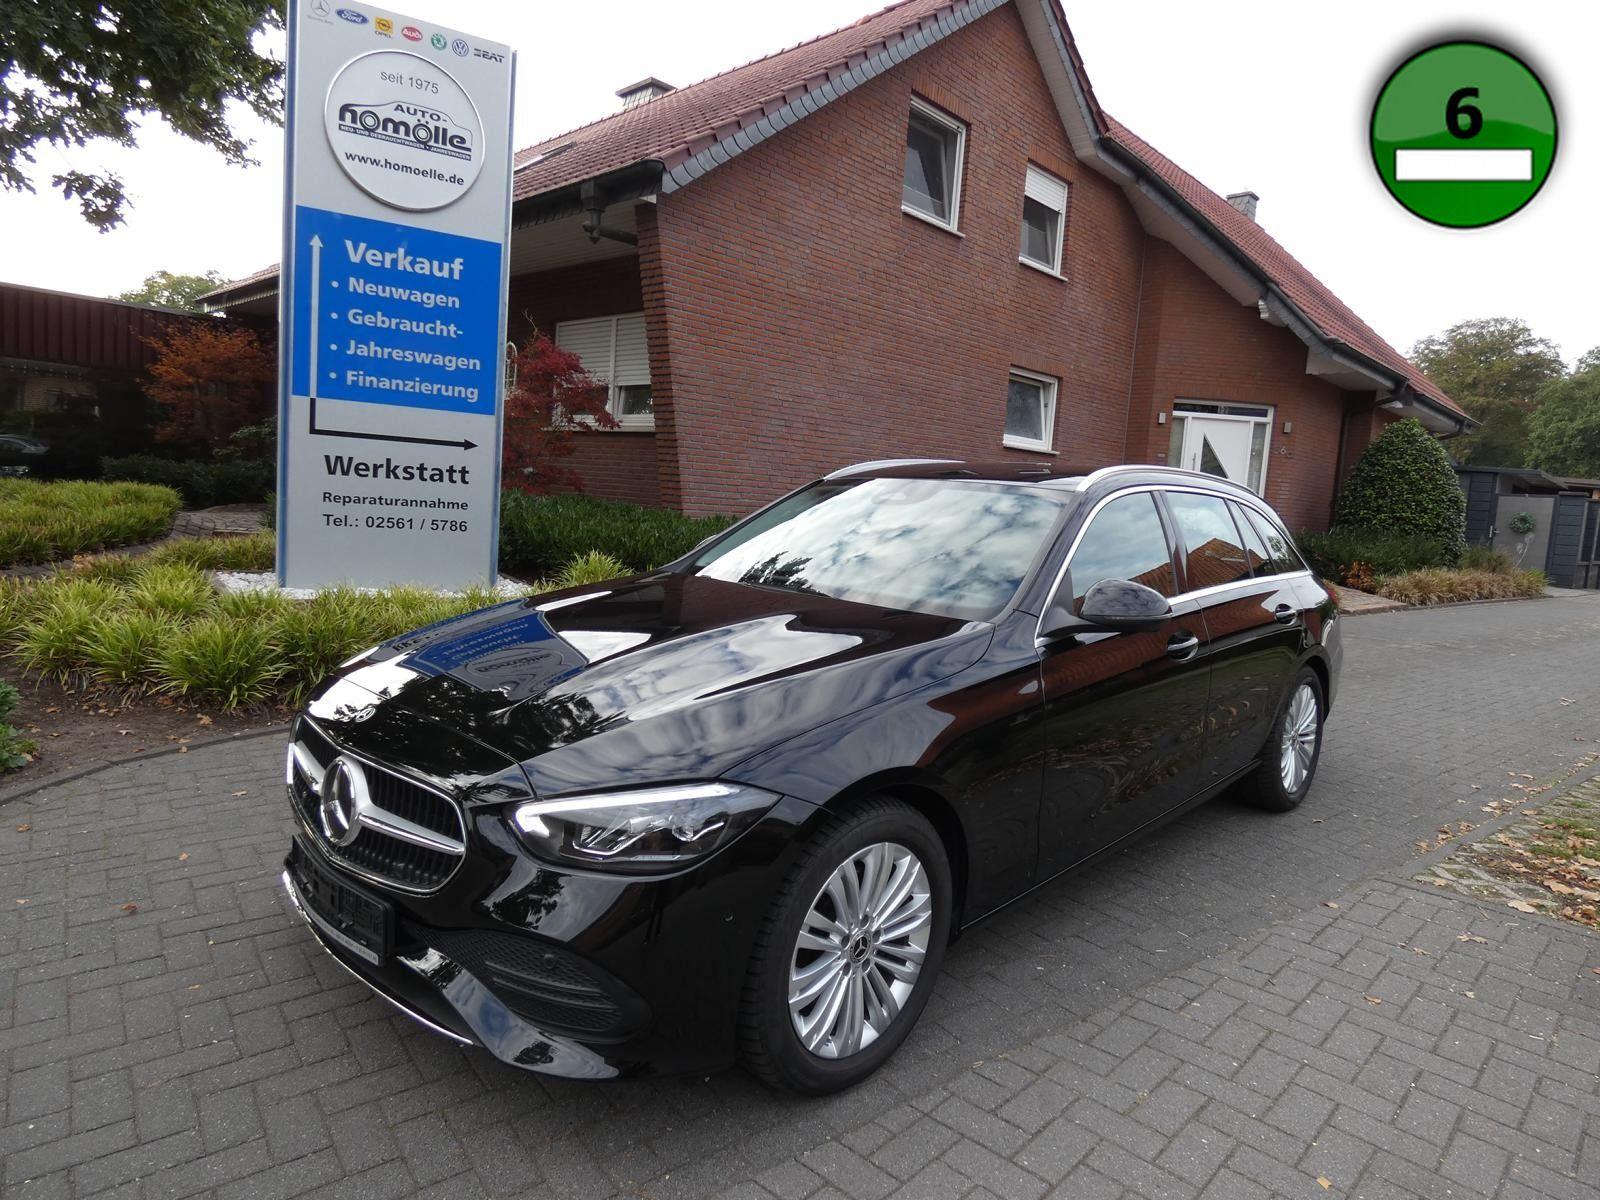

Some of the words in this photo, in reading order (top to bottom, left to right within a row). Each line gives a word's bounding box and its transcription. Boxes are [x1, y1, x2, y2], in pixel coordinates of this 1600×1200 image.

[402, 28, 422, 39] Audi
[473, 47, 505, 63] SEAT
[380, 70, 403, 87] seit
[408, 77, 439, 94] 1975
[344, 151, 465, 186] www.homoelle.de
[344, 239, 464, 281] Verkauf
[348, 276, 460, 309] Neuwagen
[347, 308, 464, 339] Gebraucht-
[345, 339, 481, 371] Jahreswagen
[345, 370, 479, 403] Finanzierung
[324, 454, 470, 485] Werkstatt
[322, 491, 469, 511] Reparaturannahme
[322, 513, 360, 528] Tel.:
[365, 516, 414, 530] 02561
[419, 518, 426, 531] /
[430, 519, 468, 532] 5786
